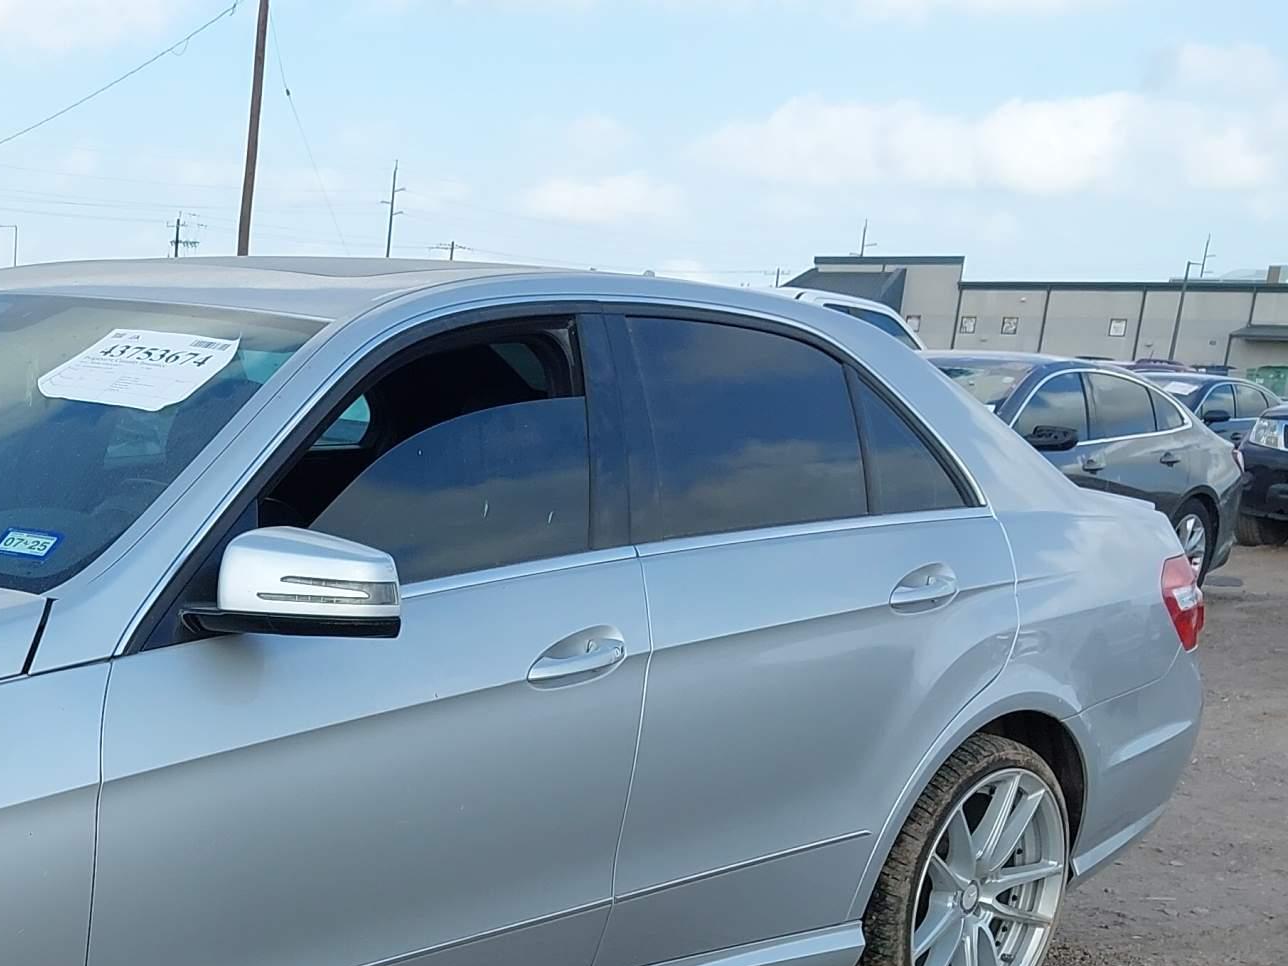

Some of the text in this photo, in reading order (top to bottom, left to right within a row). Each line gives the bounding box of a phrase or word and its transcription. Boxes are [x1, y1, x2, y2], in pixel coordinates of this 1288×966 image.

[99, 344, 214, 367] 43753674
[3, 537, 50, 552] 07 25
